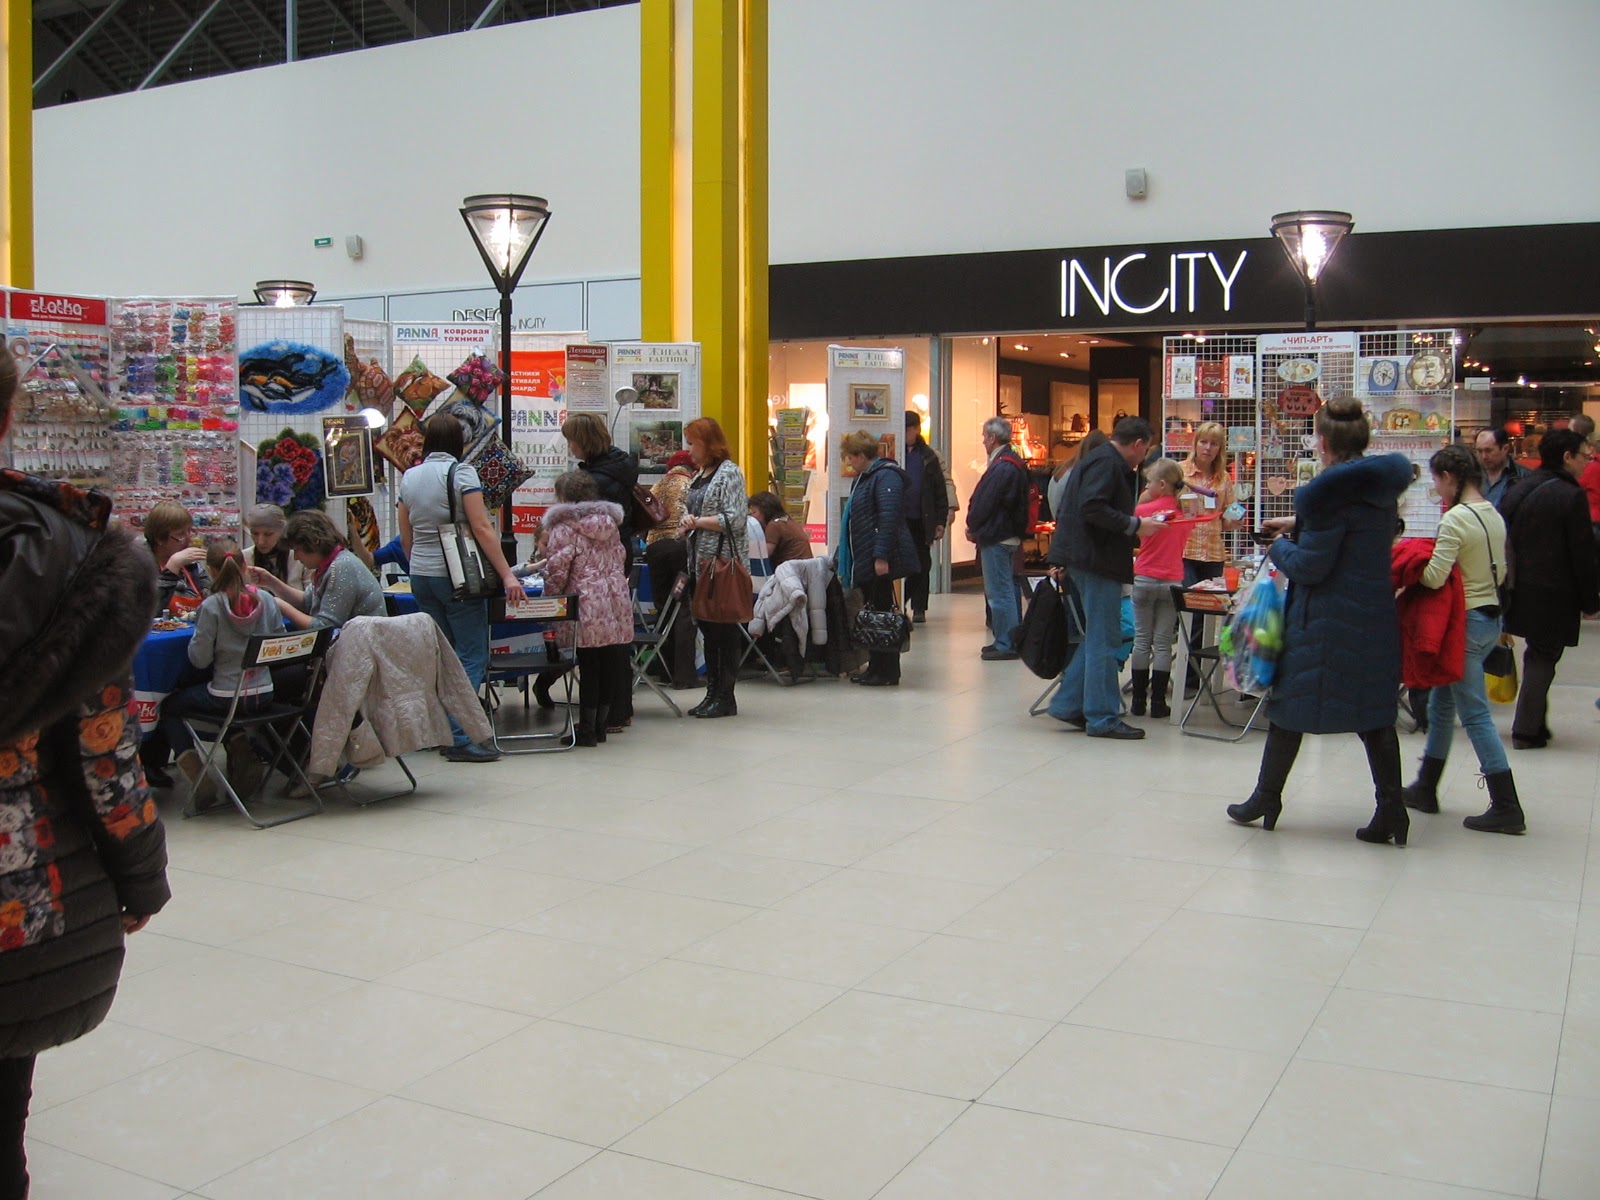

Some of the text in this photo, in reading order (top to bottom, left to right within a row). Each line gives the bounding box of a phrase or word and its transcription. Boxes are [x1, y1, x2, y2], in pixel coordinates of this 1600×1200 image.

[1060, 250, 1248, 317] INCITY
[518, 318, 546, 329] INCITY
[396, 328, 438, 338] PANNA
[568, 347, 606, 355] Леонардо
